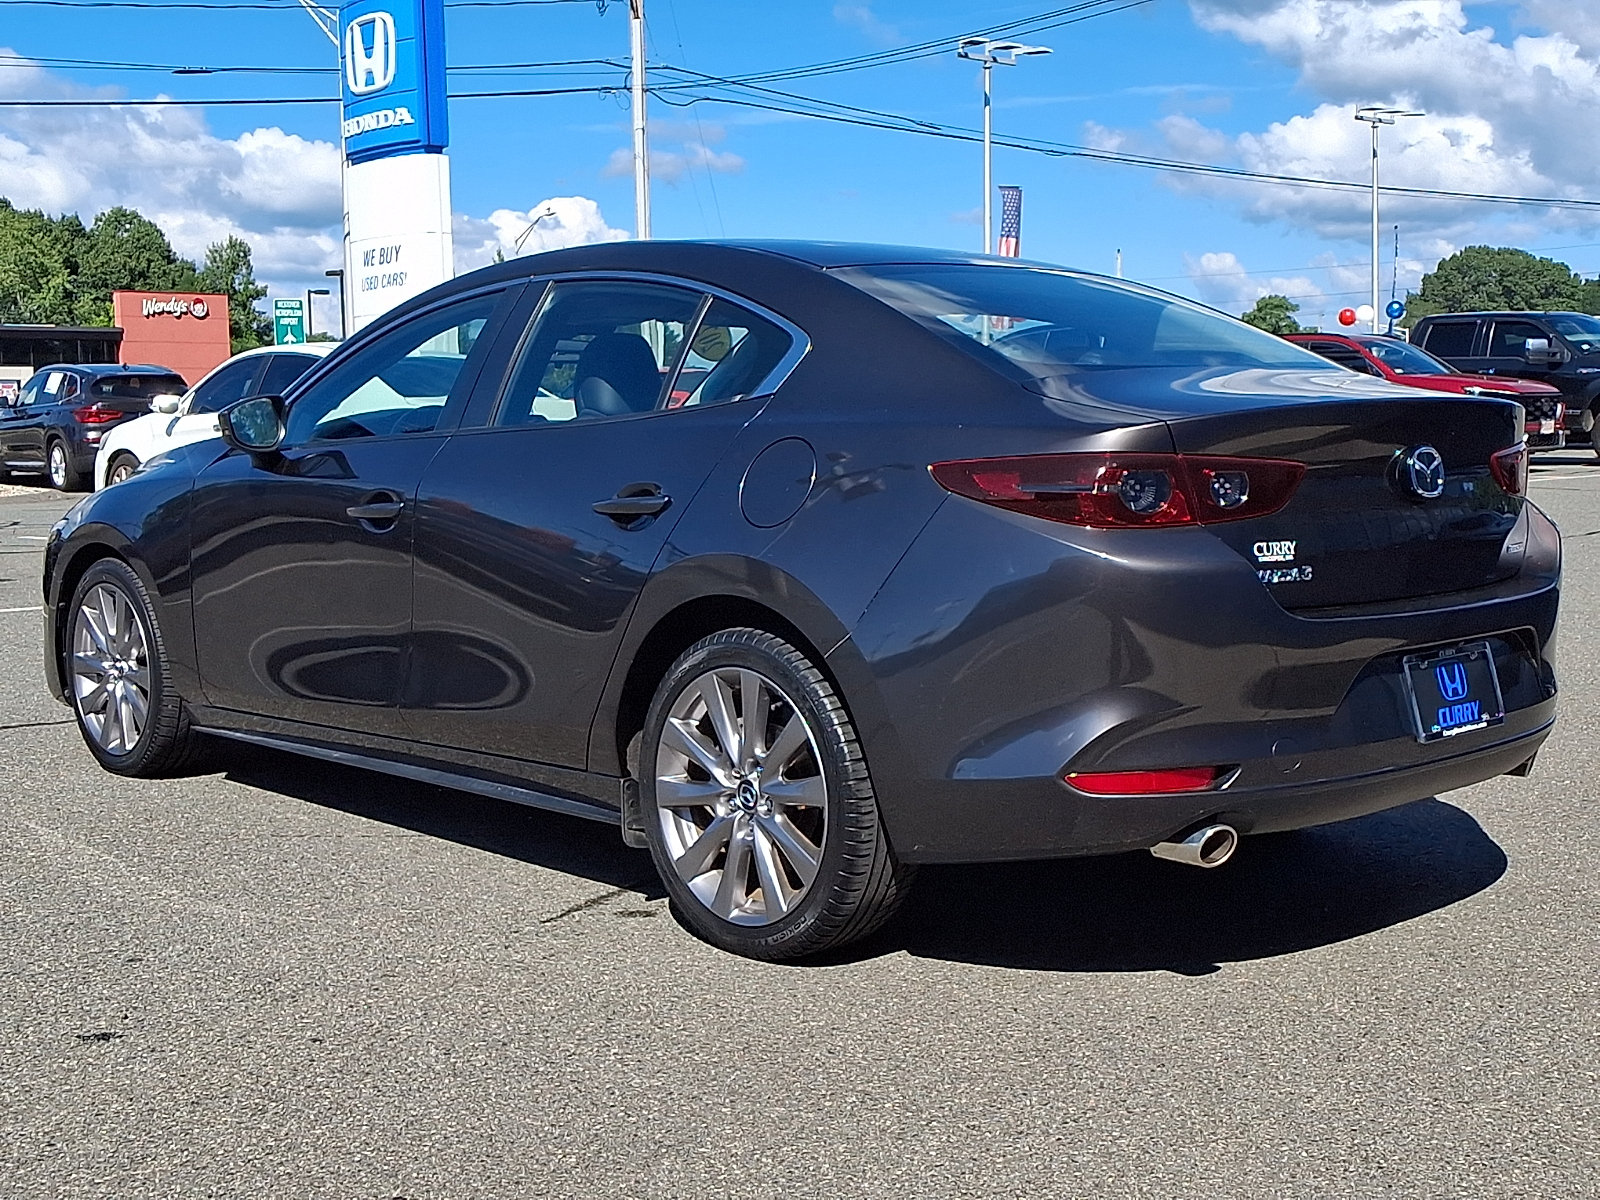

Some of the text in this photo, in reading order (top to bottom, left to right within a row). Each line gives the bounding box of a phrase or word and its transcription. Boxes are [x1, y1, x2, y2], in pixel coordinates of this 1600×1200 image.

[344, 107, 415, 138] HONDA
[363, 244, 402, 267] WE BUY
[361, 271, 408, 292] USED CARS!
[142, 296, 188, 317] Wendy's
[1253, 540, 1296, 557] CURRY
[1438, 700, 1480, 728] CURRY
